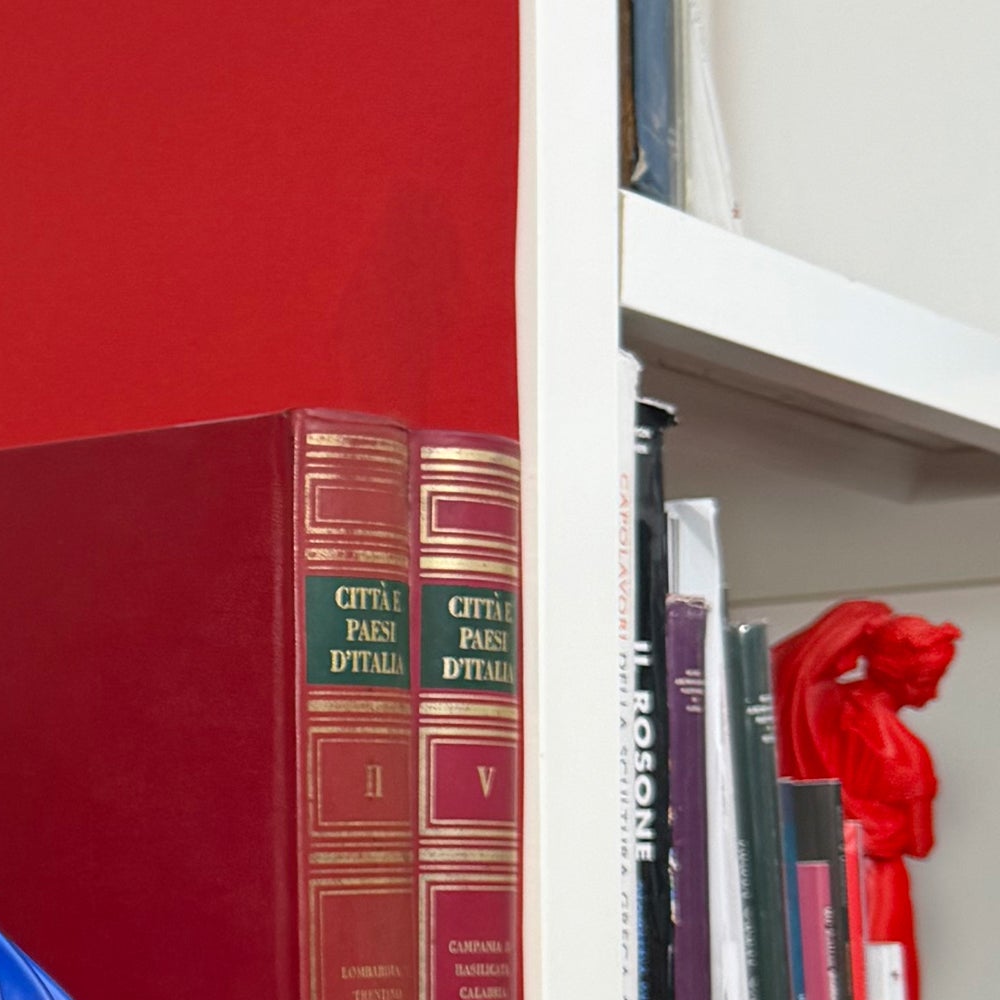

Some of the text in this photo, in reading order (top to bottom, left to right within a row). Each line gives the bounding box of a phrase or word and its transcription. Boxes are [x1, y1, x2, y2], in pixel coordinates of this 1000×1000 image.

[618, 473, 629, 641] CAPOLAVORI
[335, 581, 402, 613] CITTÀ E
[448, 592, 513, 623] CITTÀ E
[346, 619, 396, 642] PAESI
[459, 627, 508, 652] PAESI
[330, 650, 404, 675] D'ITALIA
[633, 640, 652, 667] IL
[442, 656, 514, 684] D'ITALIA
[365, 765, 383, 798] II
[476, 766, 495, 798] V
[633, 691, 656, 862] ROSONE
[449, 940, 501, 953] CAMPANIA
